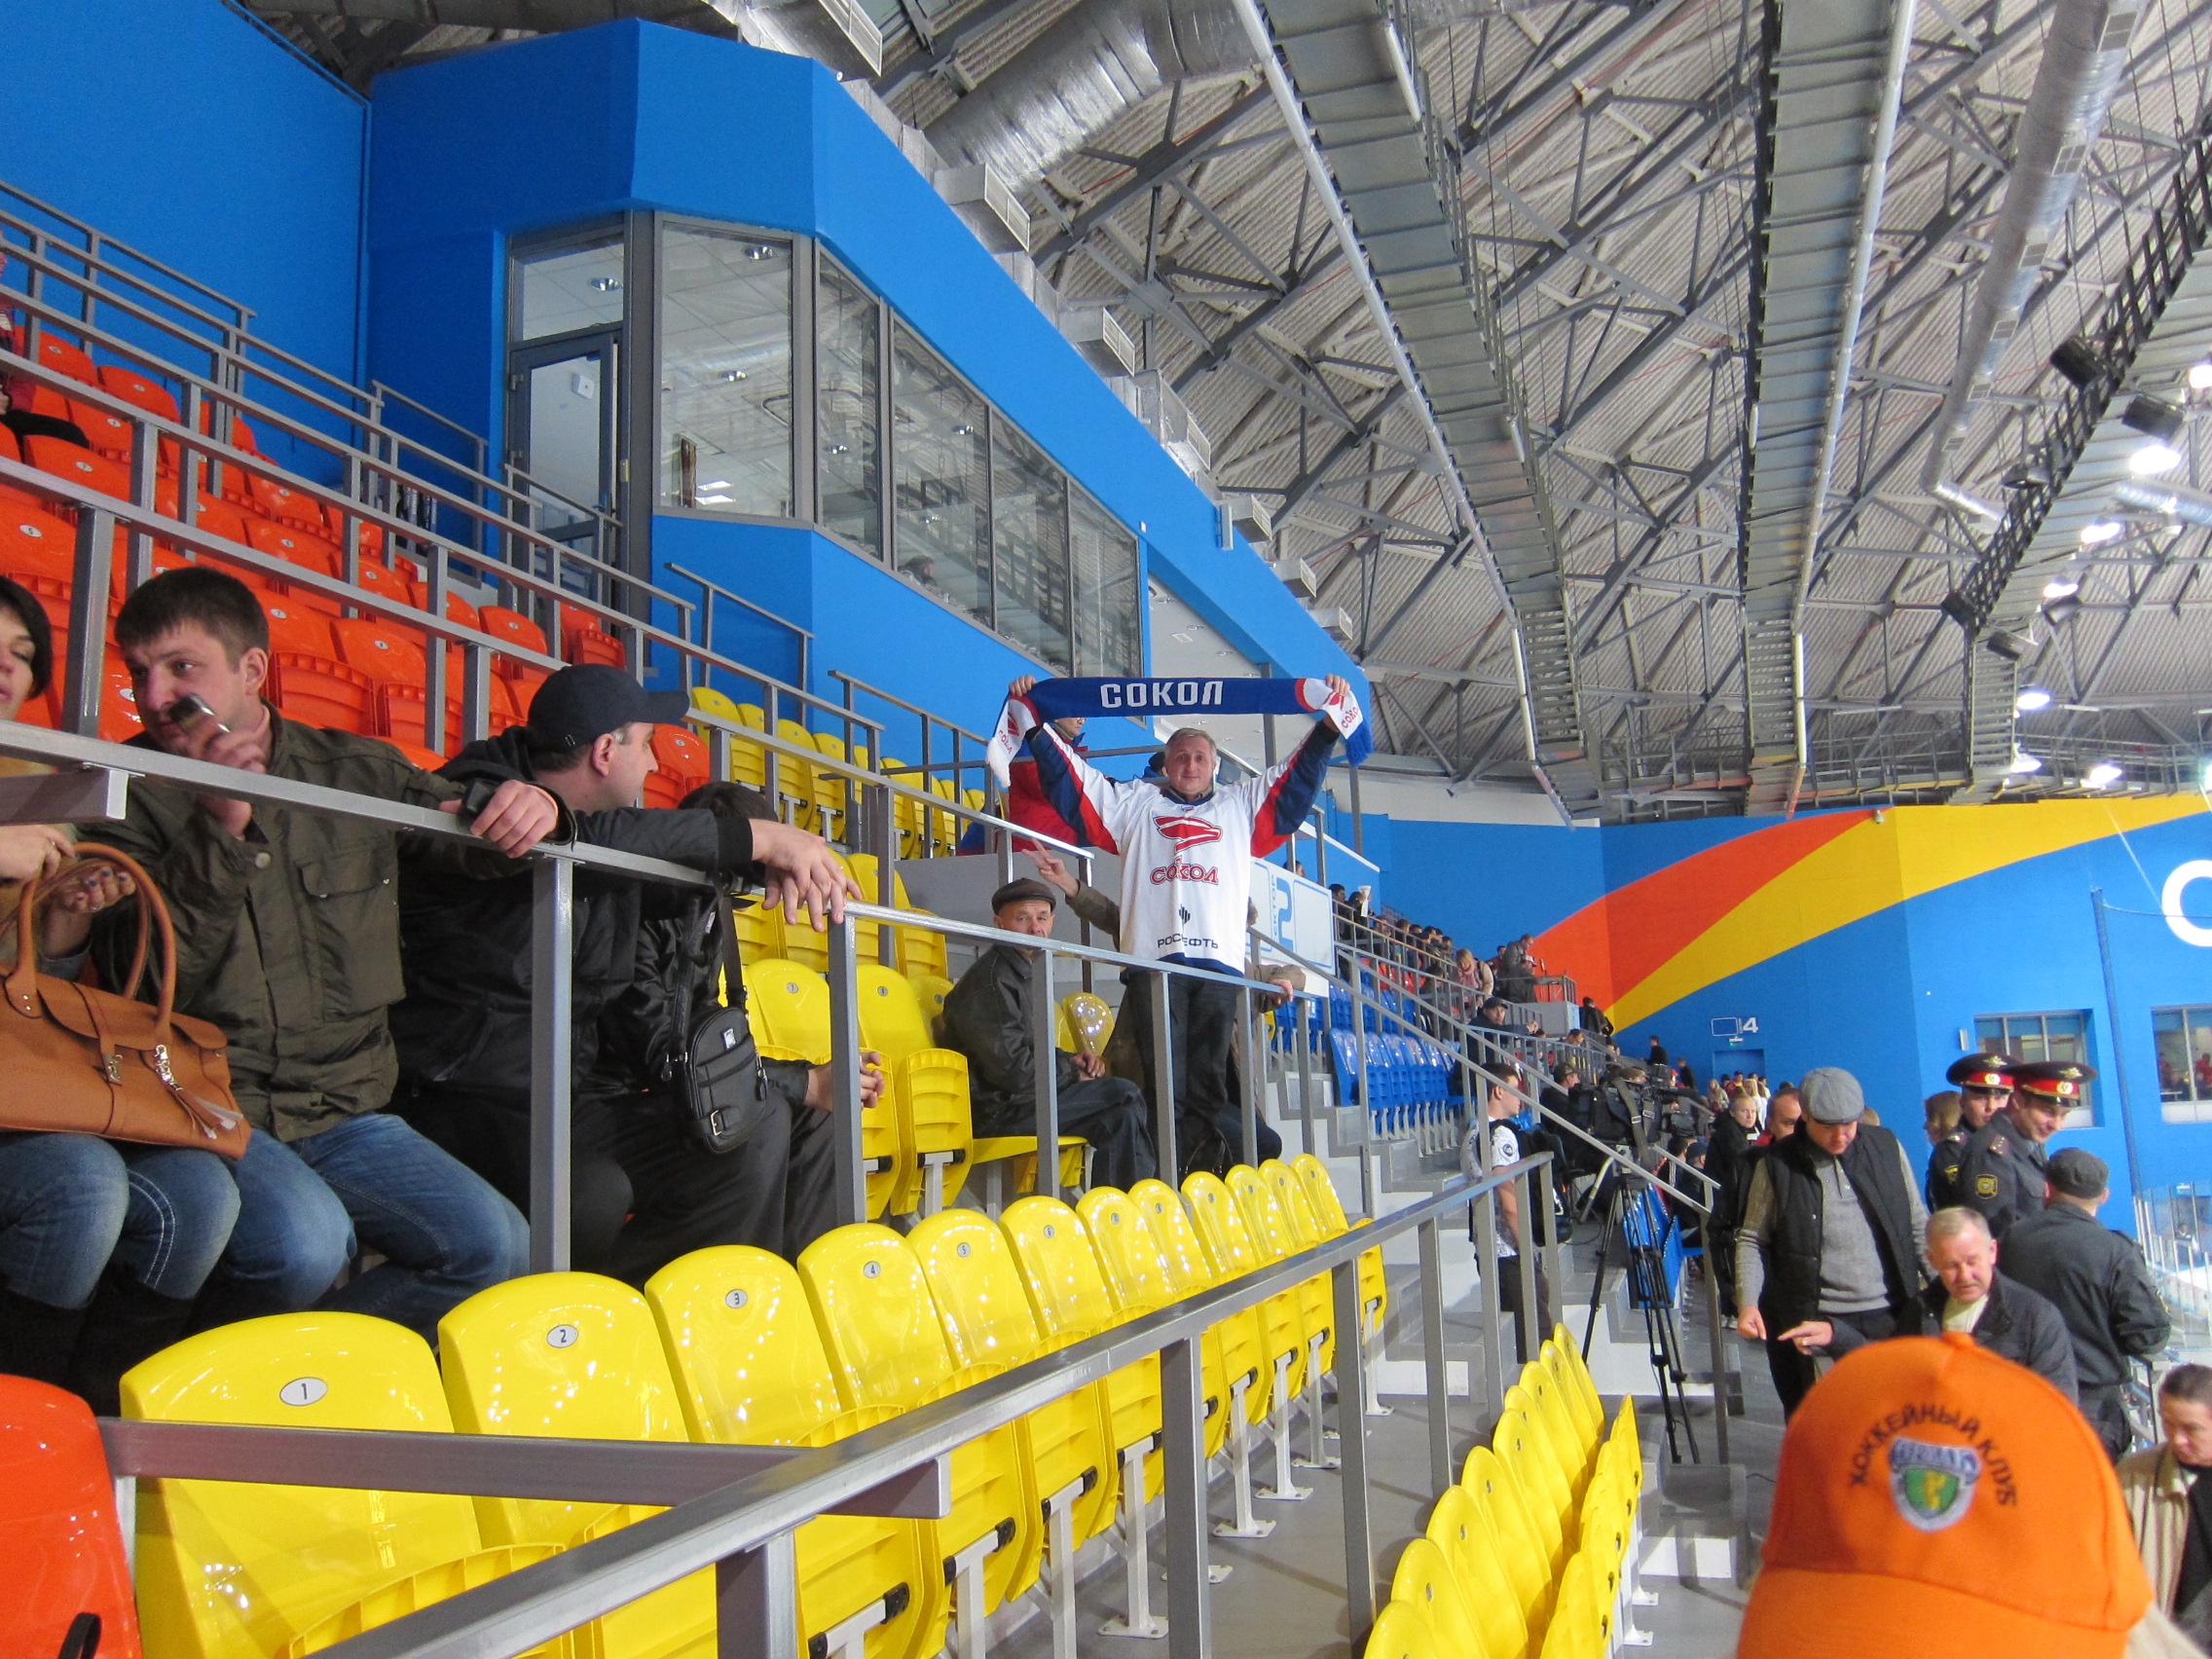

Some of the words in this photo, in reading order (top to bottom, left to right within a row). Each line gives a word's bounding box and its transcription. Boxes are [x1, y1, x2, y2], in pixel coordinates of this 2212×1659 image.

[1100, 681, 1223, 708] СОКОЛ
[1150, 855, 1219, 885] СОКОЛ
[1276, 877, 1294, 951] 2
[1743, 1016, 1759, 1033] 4
[734, 1292, 740, 1306] 3
[560, 1328, 567, 1344] 2
[301, 1382, 308, 1400] 1
